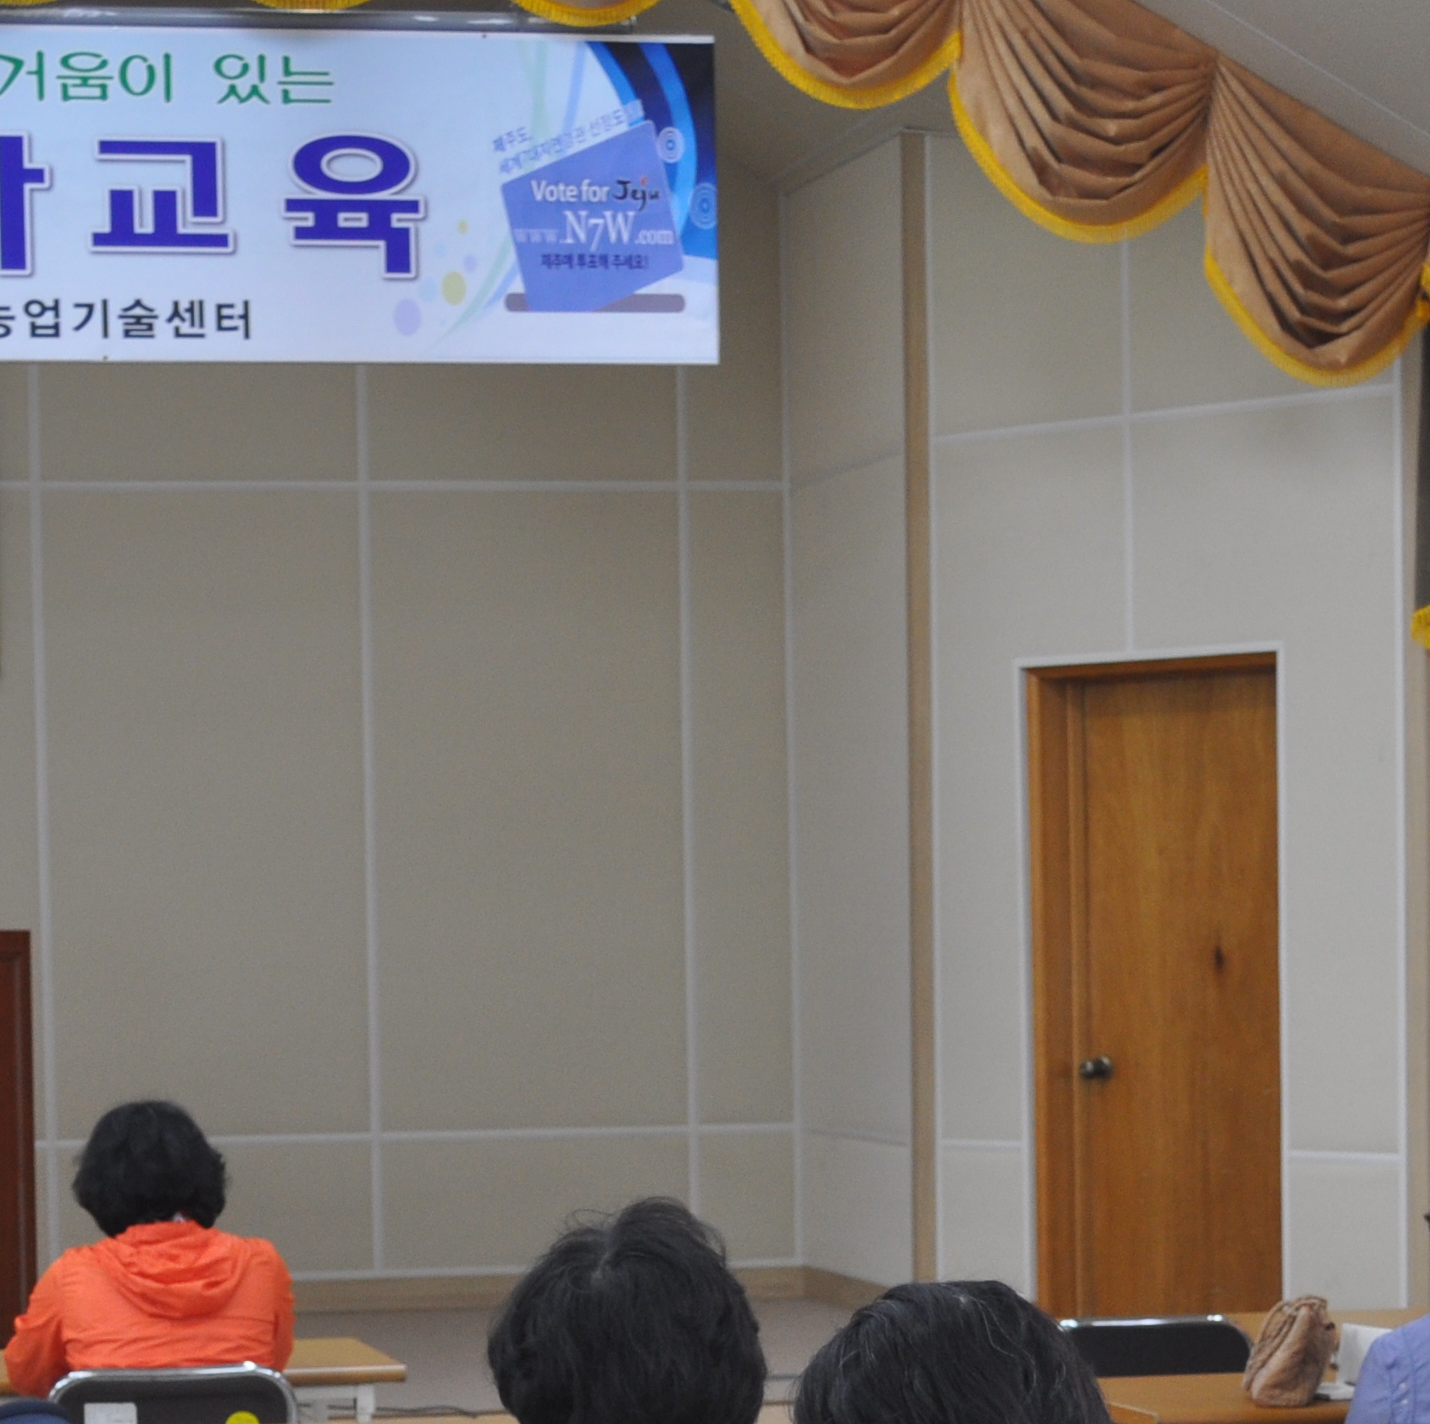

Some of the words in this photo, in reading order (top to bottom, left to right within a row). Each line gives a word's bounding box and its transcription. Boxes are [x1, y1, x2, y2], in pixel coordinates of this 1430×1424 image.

[213, 54, 337, 104] 있는
[530, 179, 578, 203] Vote
[580, 178, 610, 202] for
[613, 175, 660, 212] Jeju
[514, 209, 675, 252] www.N7W.com
